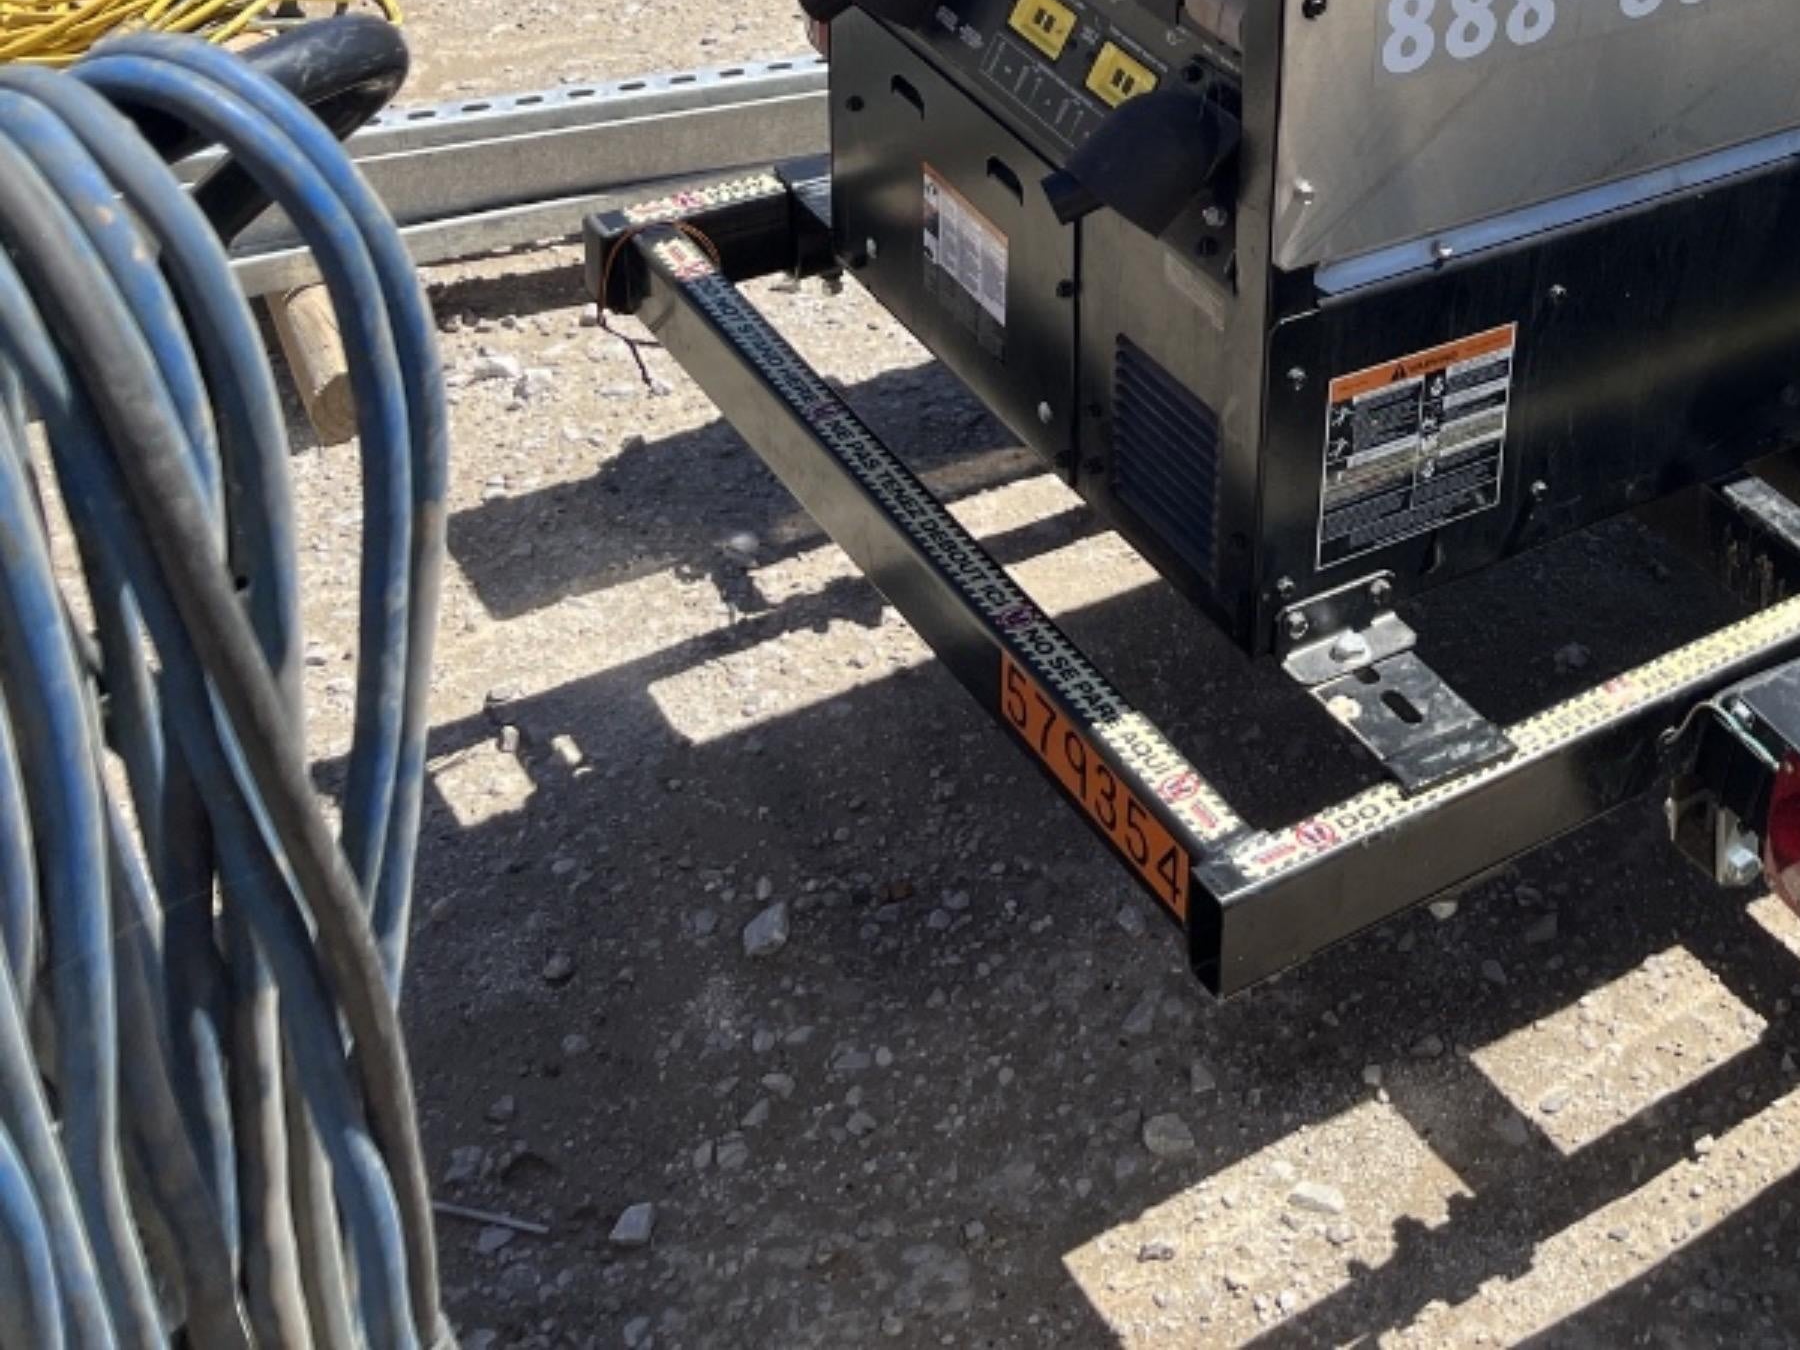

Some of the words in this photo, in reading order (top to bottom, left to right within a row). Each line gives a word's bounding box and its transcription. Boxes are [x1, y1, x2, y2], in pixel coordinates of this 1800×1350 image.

[1022, 627, 1056, 655] NO
[1049, 652, 1079, 683] SE
[1005, 663, 1183, 905] 579354
